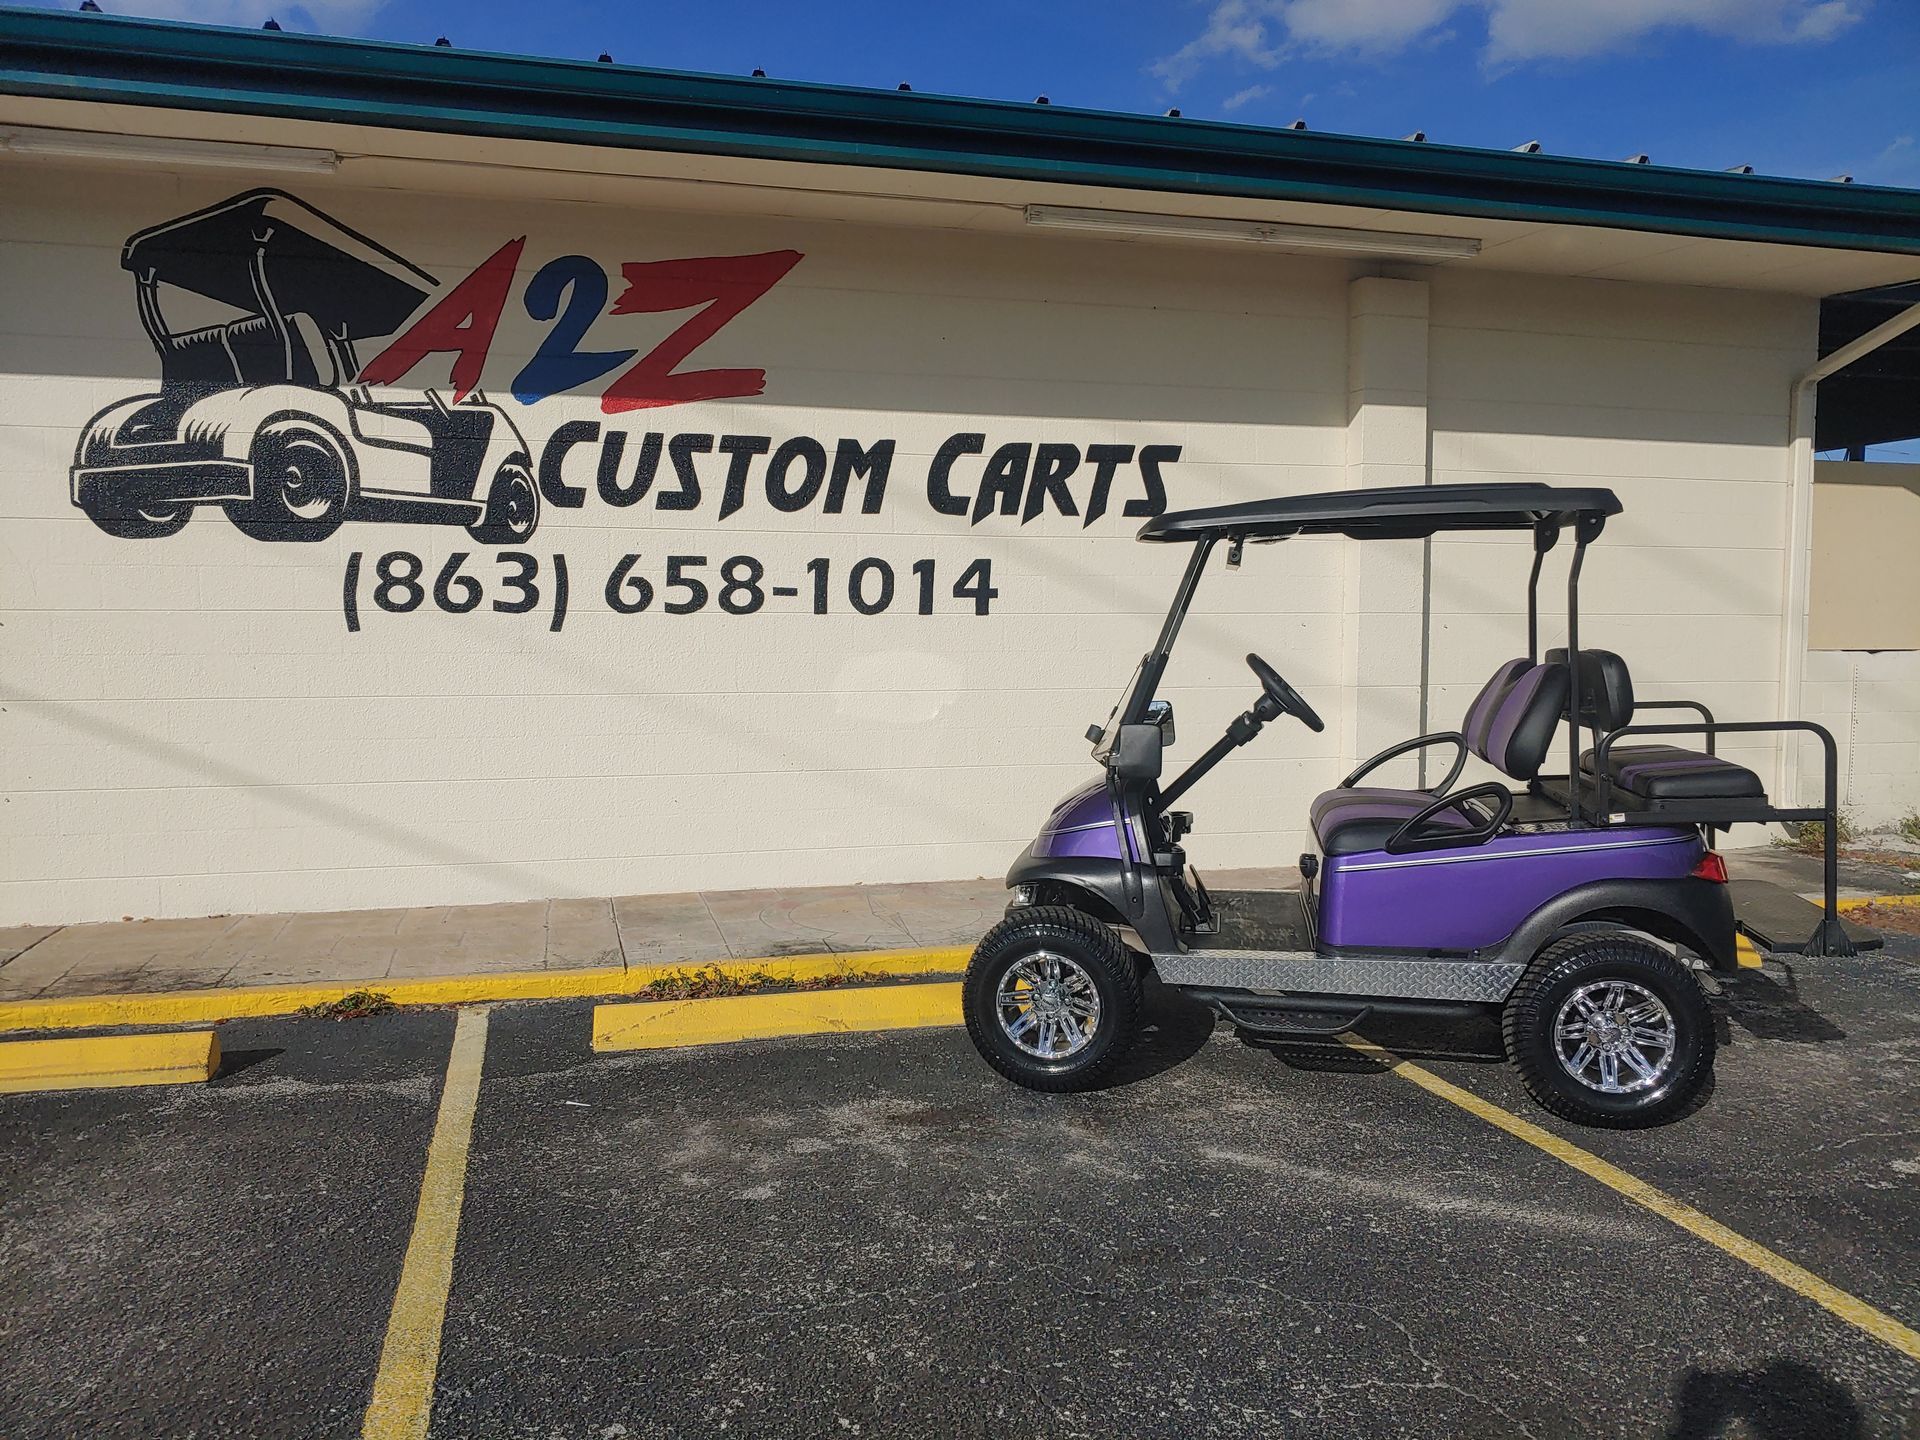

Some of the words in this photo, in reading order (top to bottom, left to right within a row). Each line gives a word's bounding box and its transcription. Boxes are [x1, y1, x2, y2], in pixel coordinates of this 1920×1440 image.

[357, 236, 806, 414] A2Z
[539, 420, 896, 521] CUSTOM
[926, 433, 1183, 529] CARTS
[344, 551, 569, 633] (863)
[604, 555, 999, 616] 658-1014
